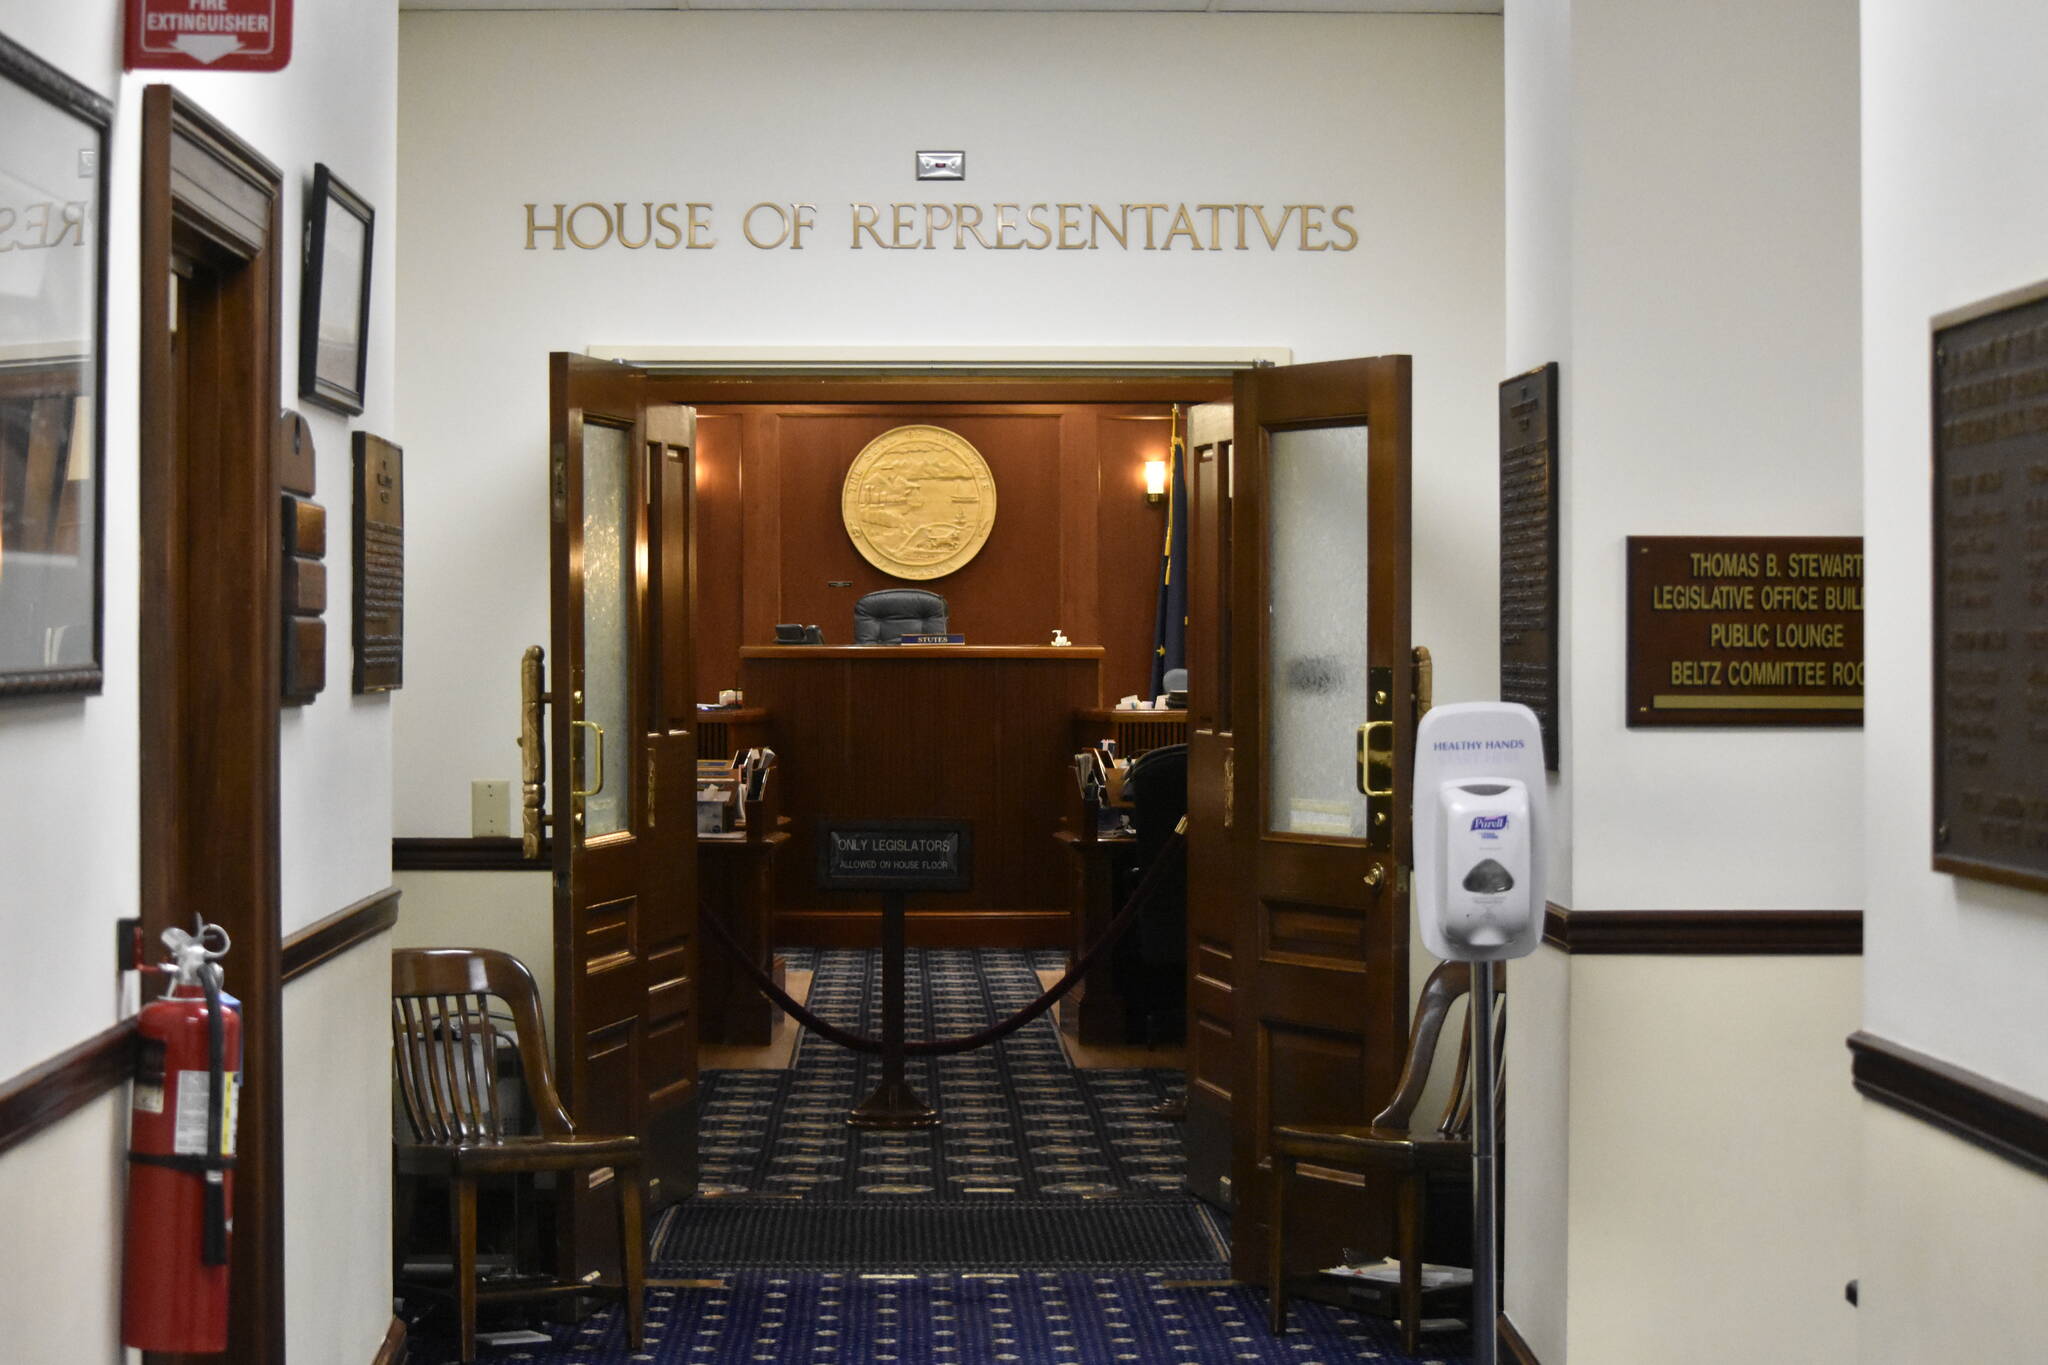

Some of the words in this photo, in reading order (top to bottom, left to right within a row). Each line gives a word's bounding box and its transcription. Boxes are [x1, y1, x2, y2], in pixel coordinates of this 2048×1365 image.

[147, 13, 269, 32] EXTINGUISHER
[524, 202, 718, 250] HOUSE
[743, 202, 817, 250] OF
[850, 202, 1359, 251] REPRESENTATIVES
[1690, 553, 1759, 577] THOMAS
[1766, 553, 1781, 577] B.
[1788, 553, 1864, 577] STEWART
[1653, 585, 1754, 610] LEGISLATIVE
[1761, 586, 1818, 610] OFFICE
[1711, 623, 1769, 648] PUBLIC
[1776, 624, 1844, 648] LOUNGE
[1671, 661, 1722, 685] BELTZ
[1727, 661, 1826, 686] COMMITTEE
[1433, 742, 1481, 752] HEALTHY
[1485, 740, 1525, 750] HANDS
[837, 839, 867, 851] ONLY
[872, 839, 950, 852] LEGISLATORS
[840, 860, 877, 869] ALLOWED
[880, 860, 891, 869] ON
[894, 860, 920, 869] HOUSE
[922, 860, 948, 870] FLOOR
